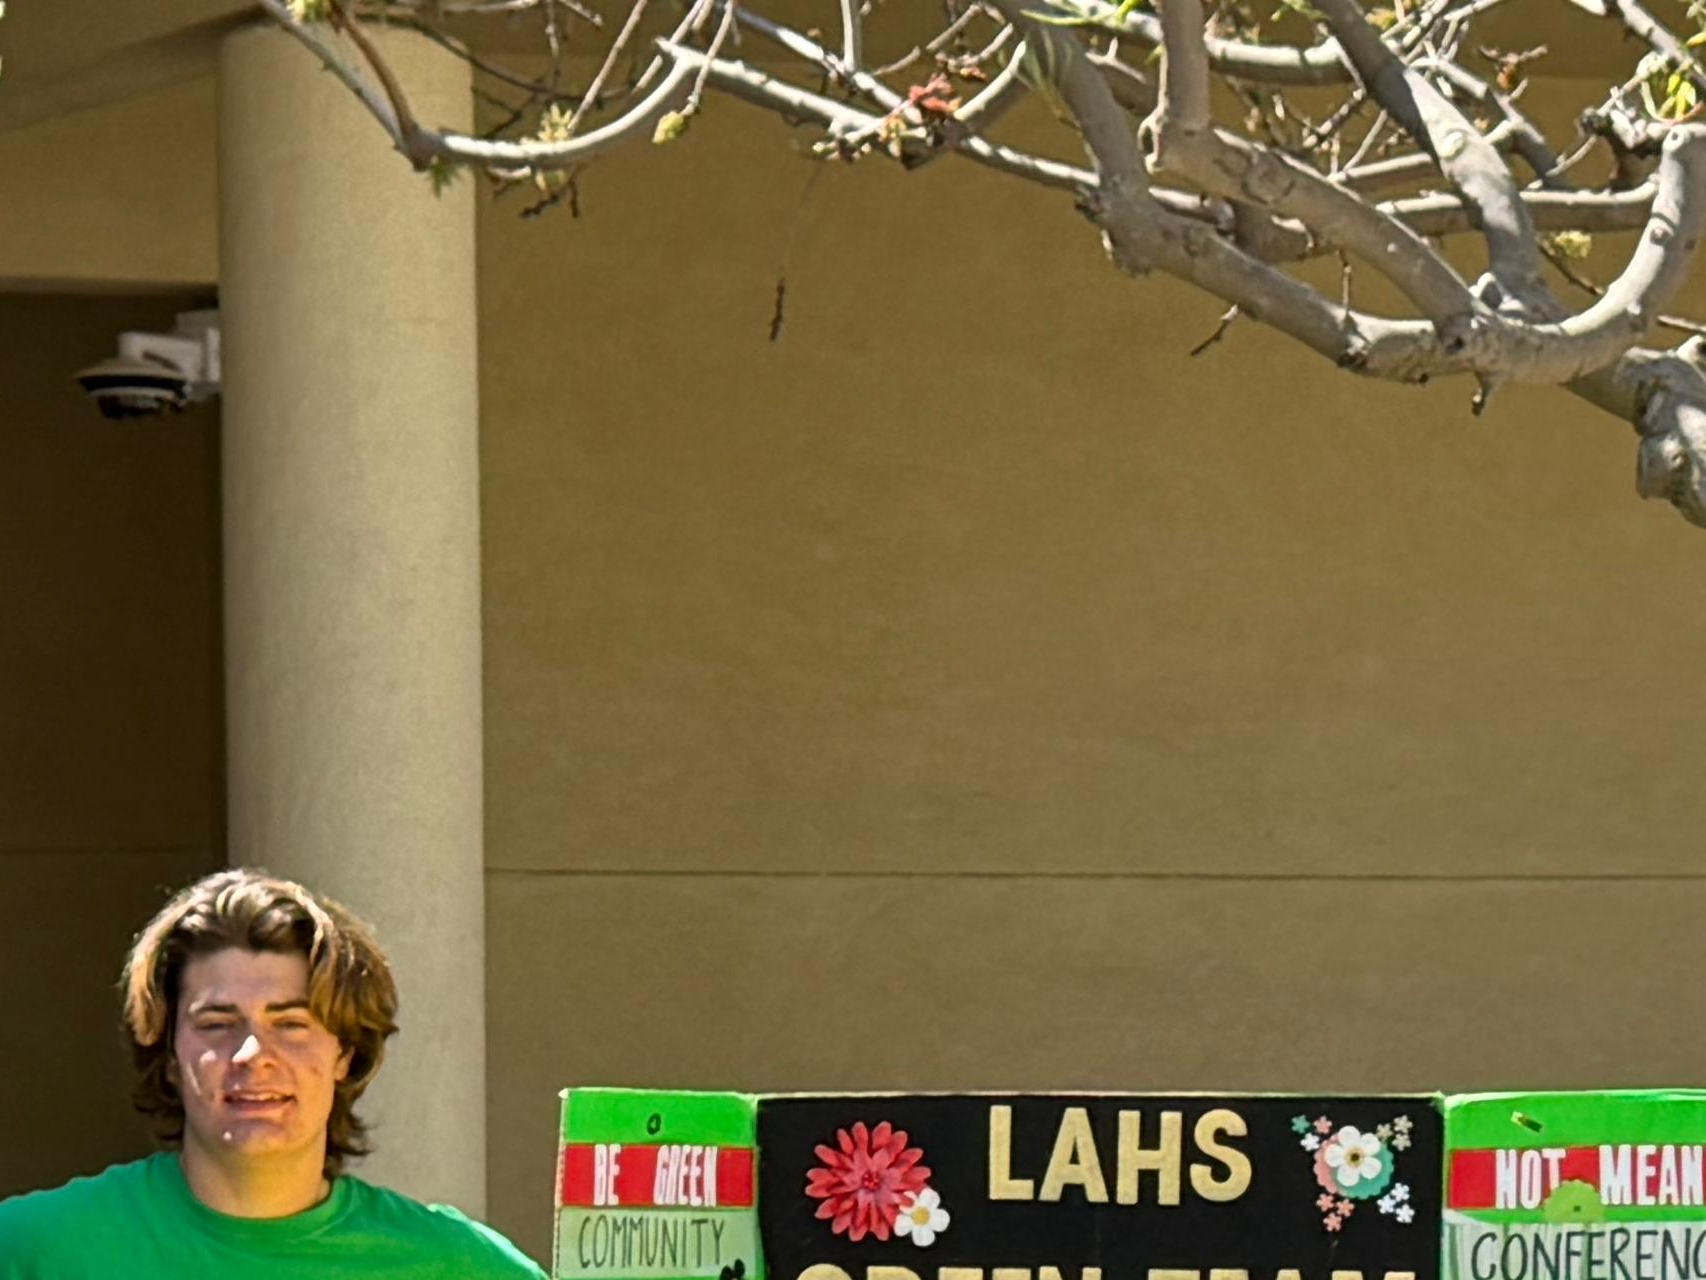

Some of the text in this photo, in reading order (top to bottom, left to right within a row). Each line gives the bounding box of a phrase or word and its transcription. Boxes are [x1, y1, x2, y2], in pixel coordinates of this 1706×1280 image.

[593, 1144, 718, 1207] BE GREEN
[989, 1105, 1252, 1204] LAHS
[1495, 1144, 1704, 1209] NOT MEAN
[577, 1215, 725, 1270] COMMUNITY
